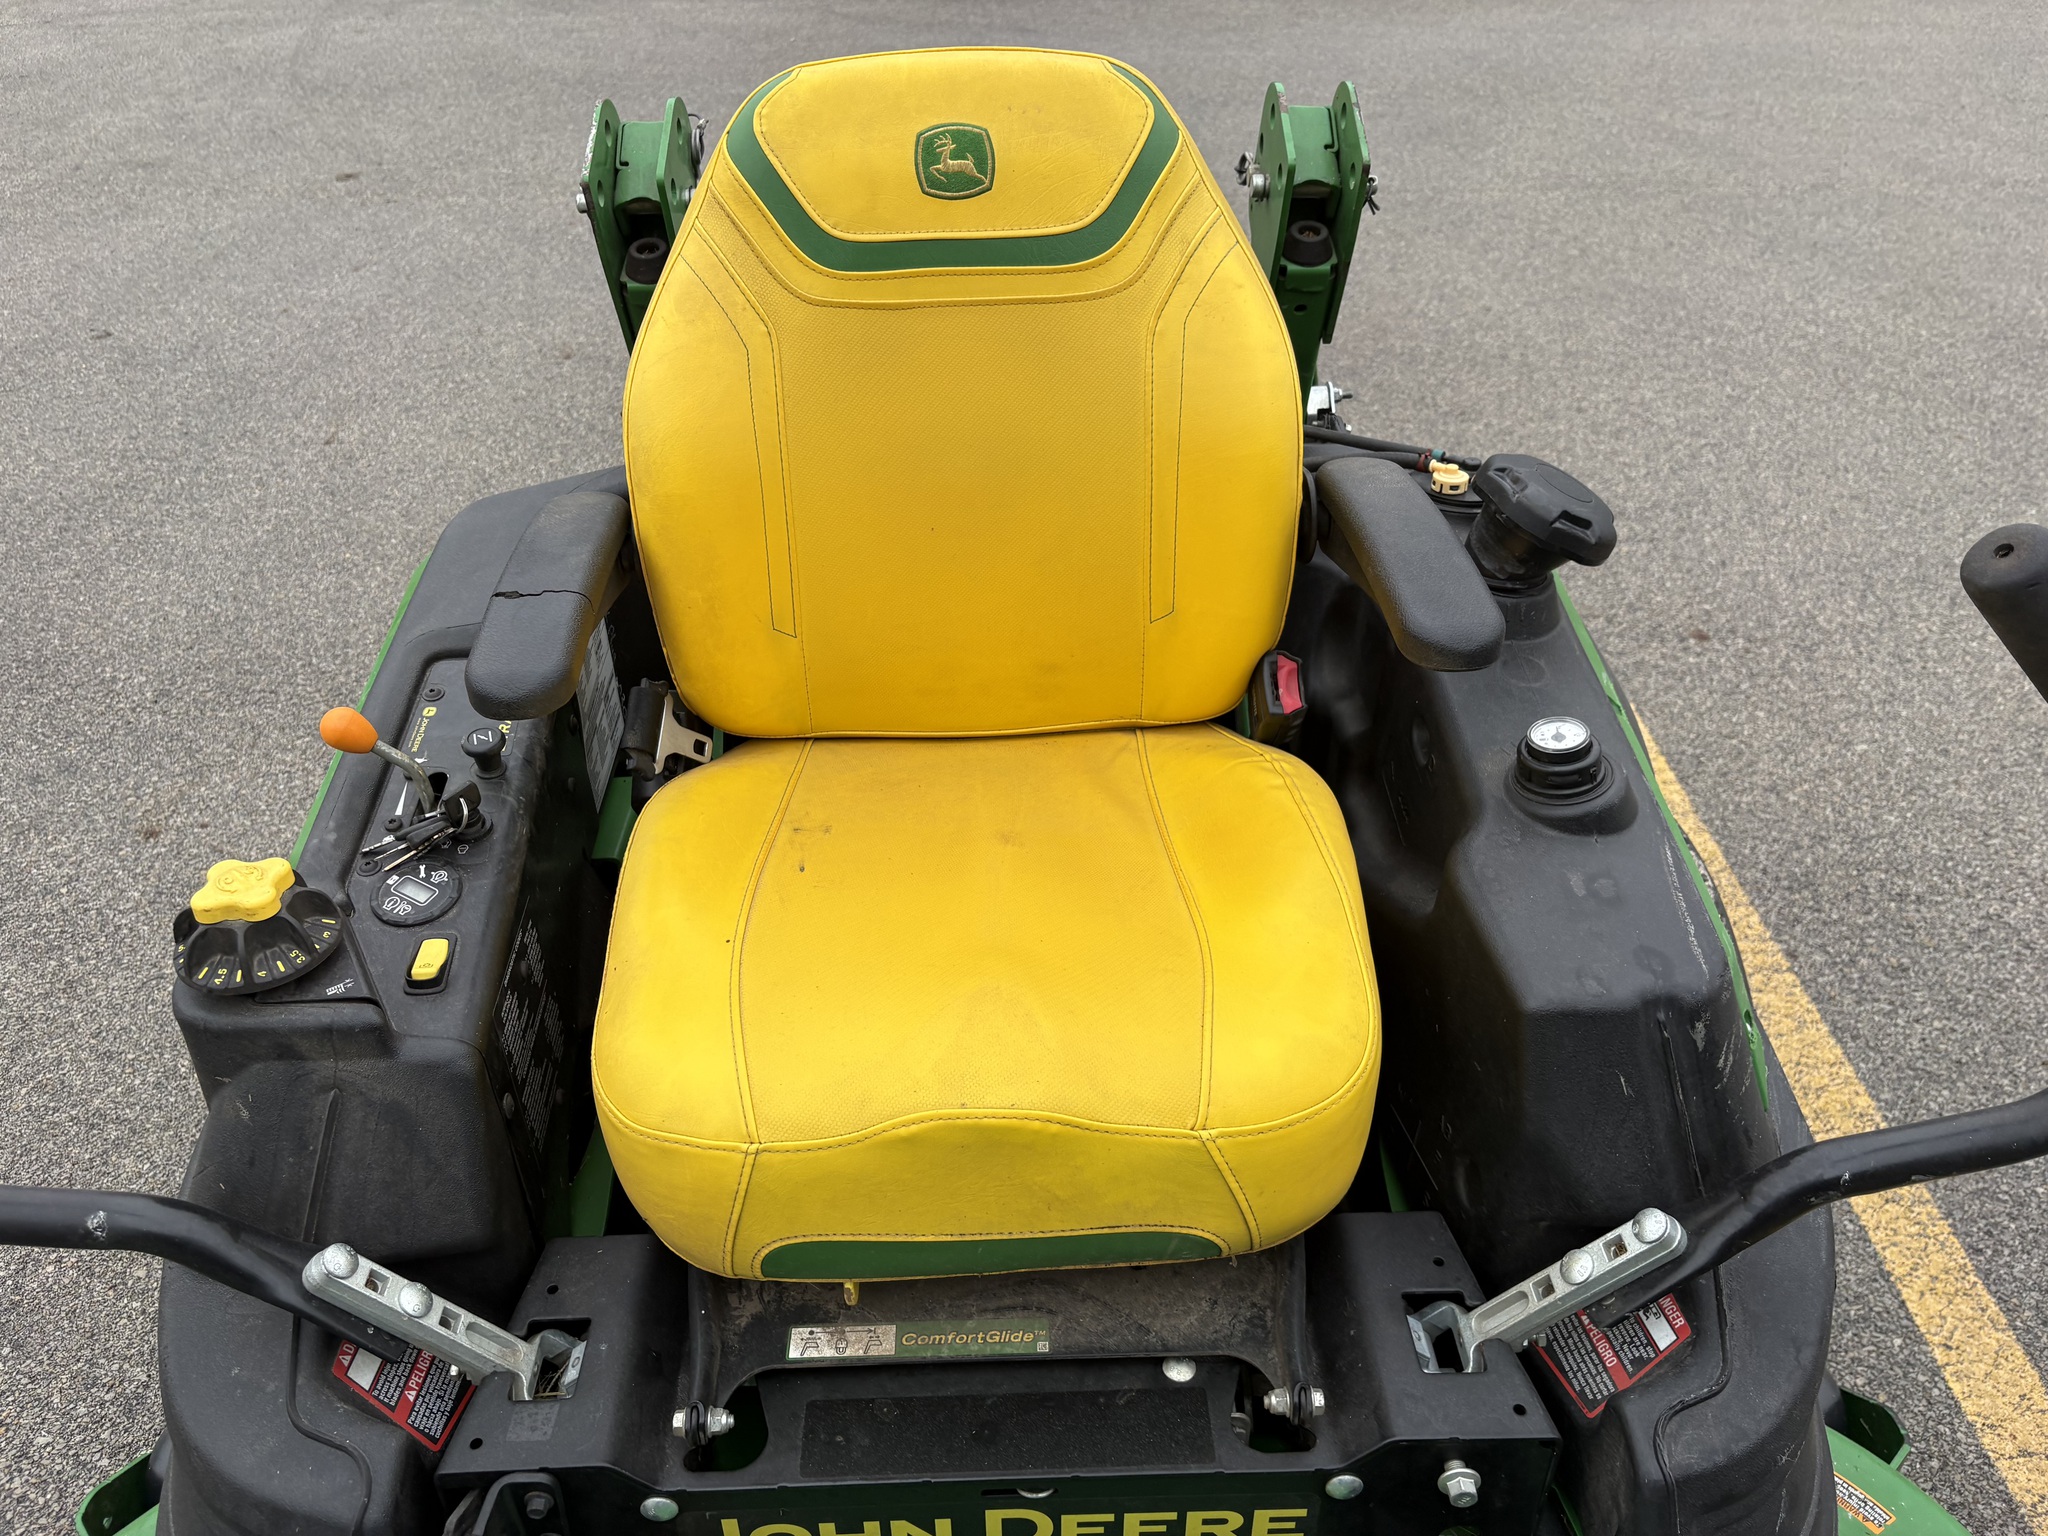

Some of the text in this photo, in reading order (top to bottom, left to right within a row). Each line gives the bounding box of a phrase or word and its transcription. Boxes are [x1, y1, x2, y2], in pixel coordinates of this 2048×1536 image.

[1658, 1296, 1685, 1329] NGER
[1586, 1321, 1617, 1368] PELIGRO
[1605, 1329, 1620, 1351] pecially
[408, 1349, 432, 1390] PELIGR
[985, 1508, 1310, 1536] DEERE
